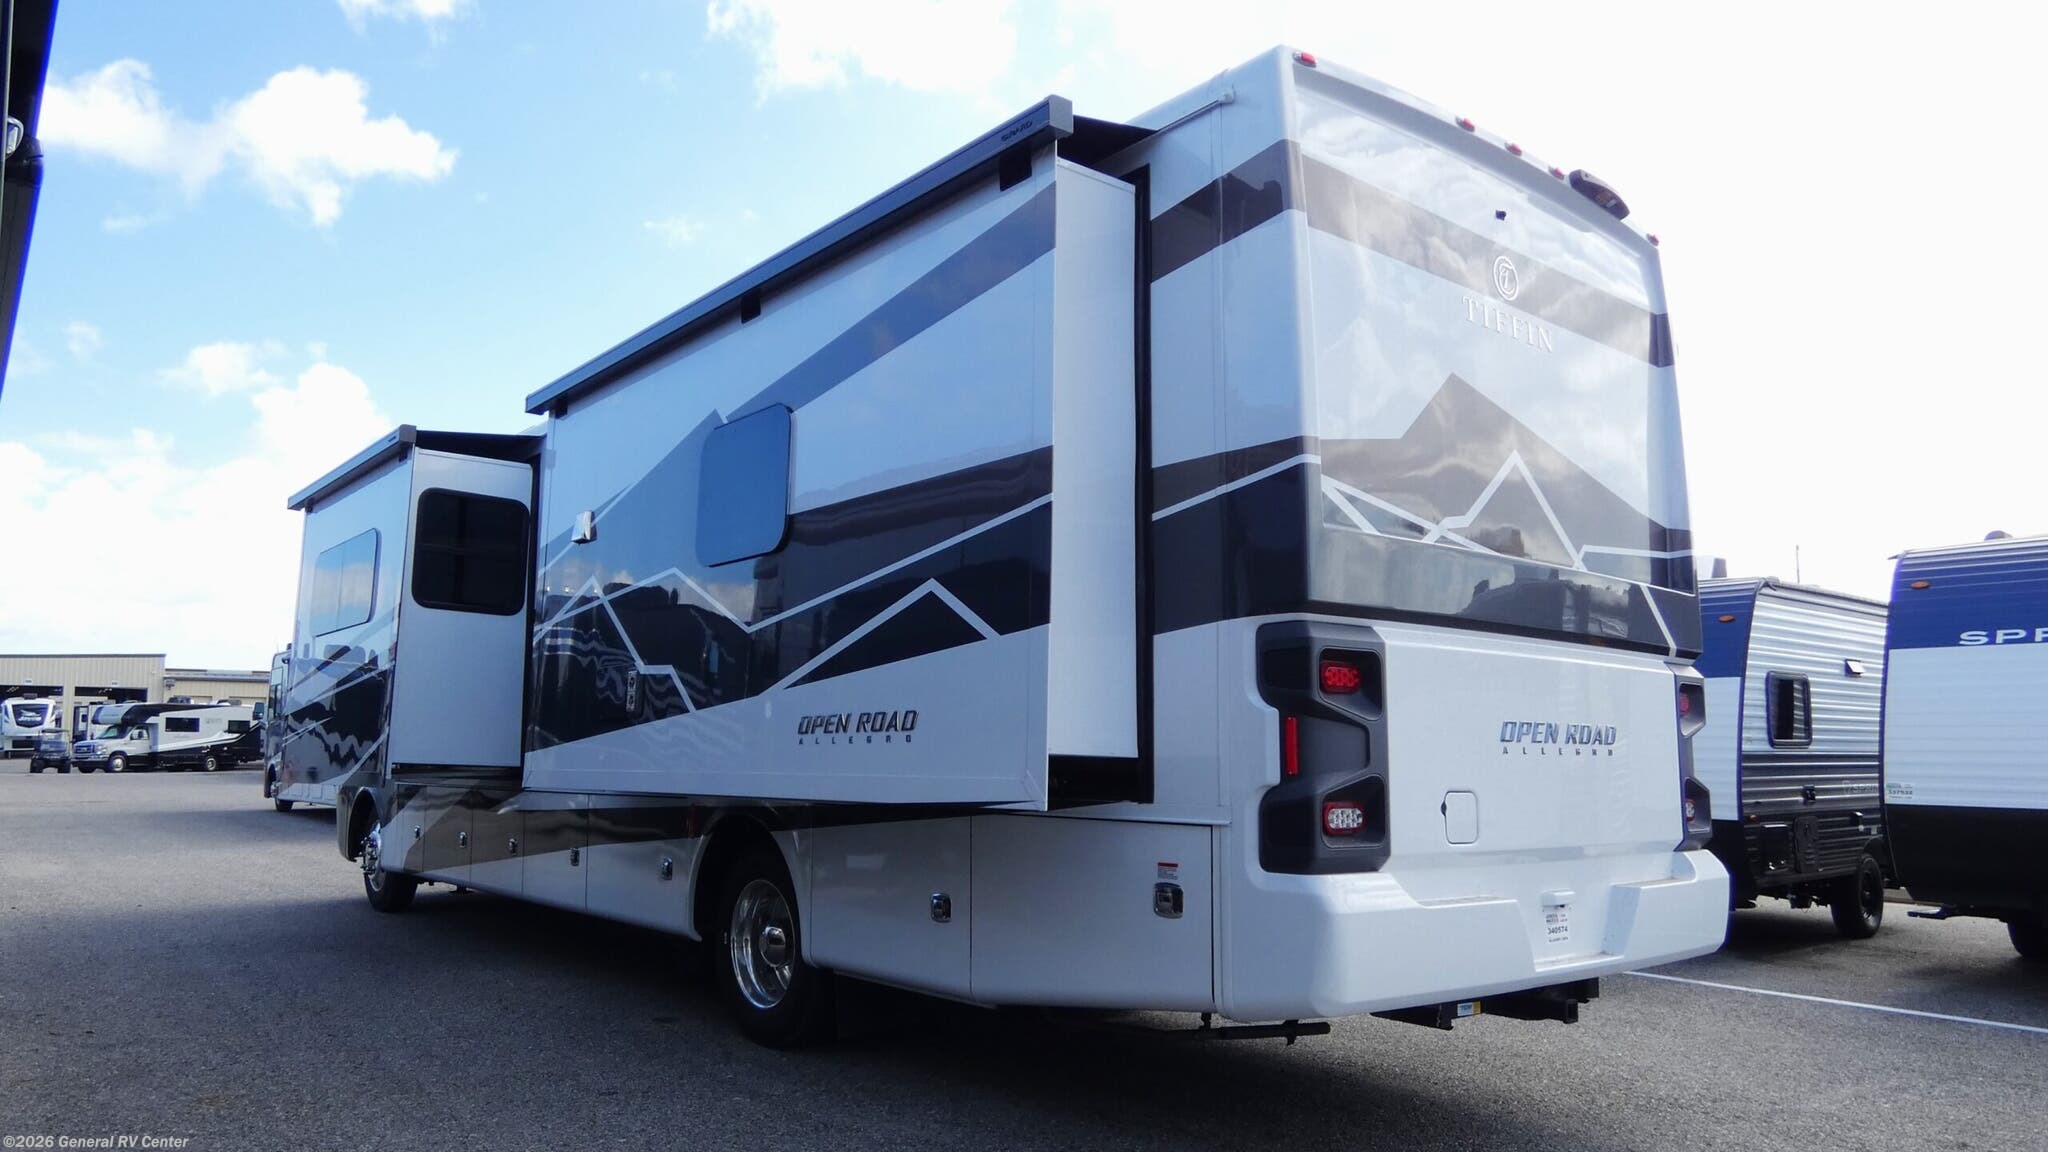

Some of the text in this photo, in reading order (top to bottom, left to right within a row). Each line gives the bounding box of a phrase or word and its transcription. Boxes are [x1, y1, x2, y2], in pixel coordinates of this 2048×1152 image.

[1463, 296, 1552, 352] TIFFIN
[798, 710, 919, 735] OPEN ROAD
[1500, 721, 1617, 746] OPEN ROAD
[798, 734, 912, 745] ALLEGRO
[1502, 746, 1613, 757] ALLEGRO
